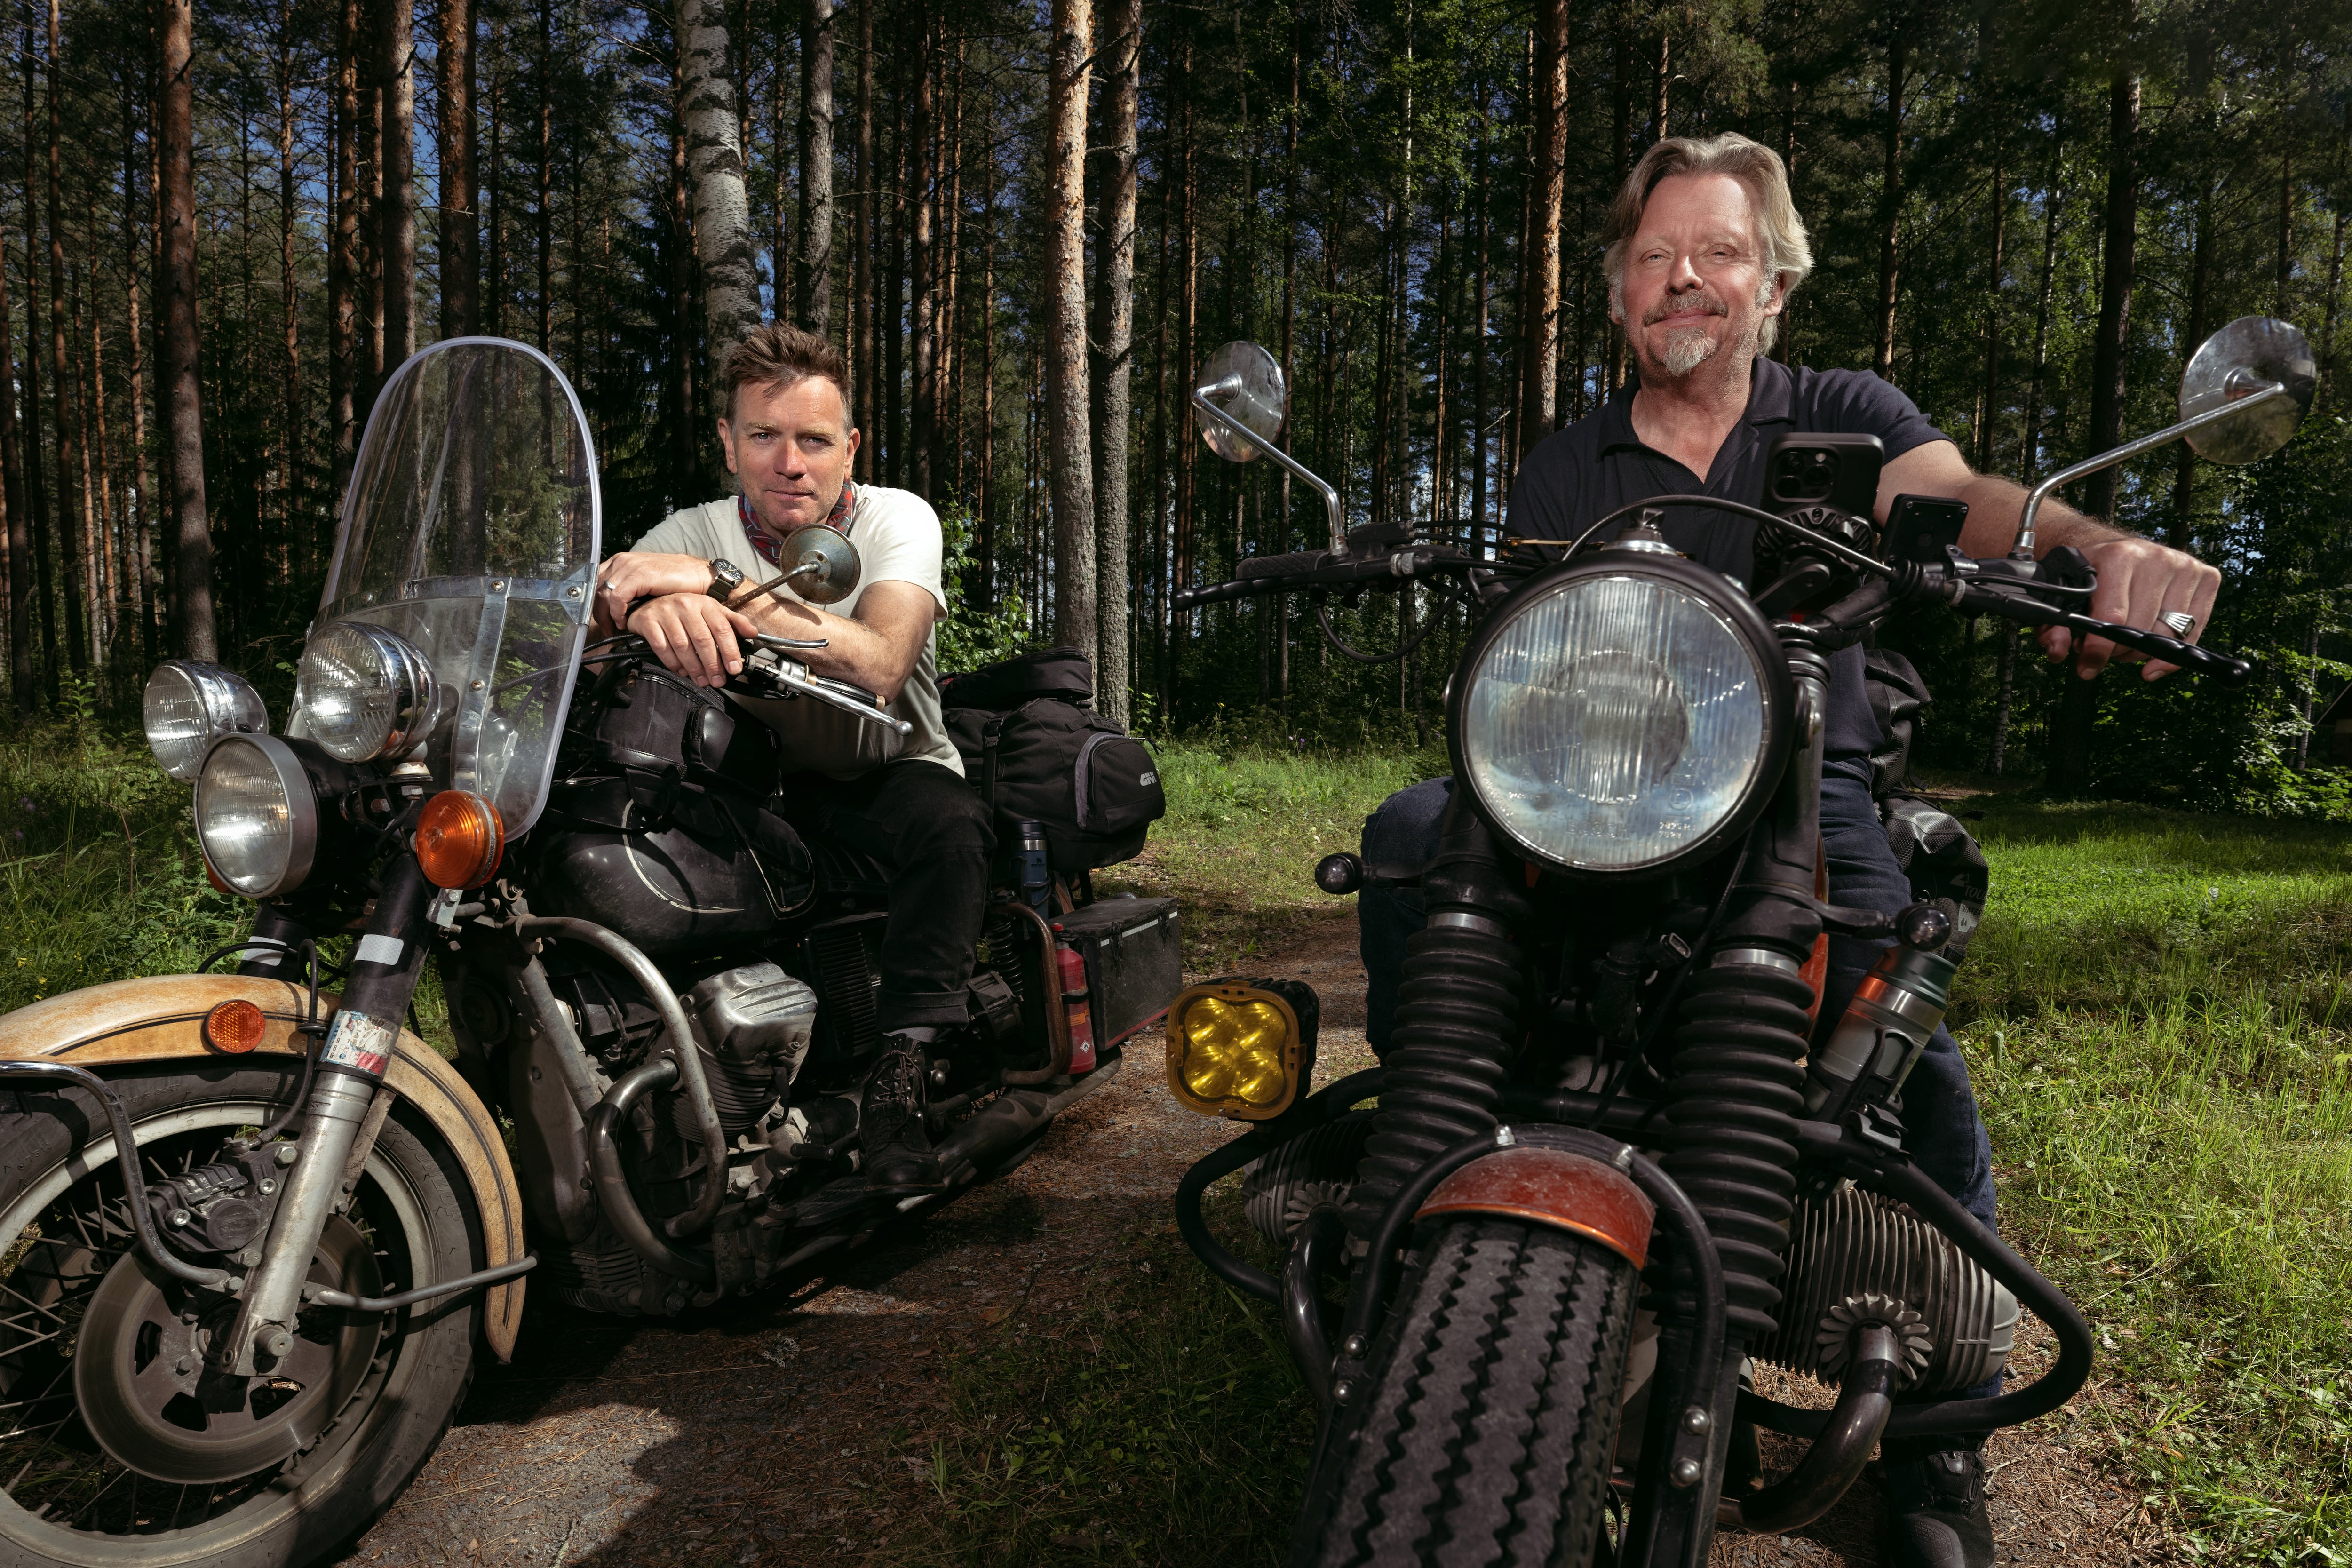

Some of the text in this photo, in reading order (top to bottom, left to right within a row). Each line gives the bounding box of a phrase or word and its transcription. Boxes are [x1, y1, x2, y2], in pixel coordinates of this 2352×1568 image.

[1140, 771, 1157, 787] GIVI
[1565, 819, 1630, 840] BOSCH
[1964, 885, 1987, 900] TOU
[400, 1139, 463, 1222] DUNLOP
